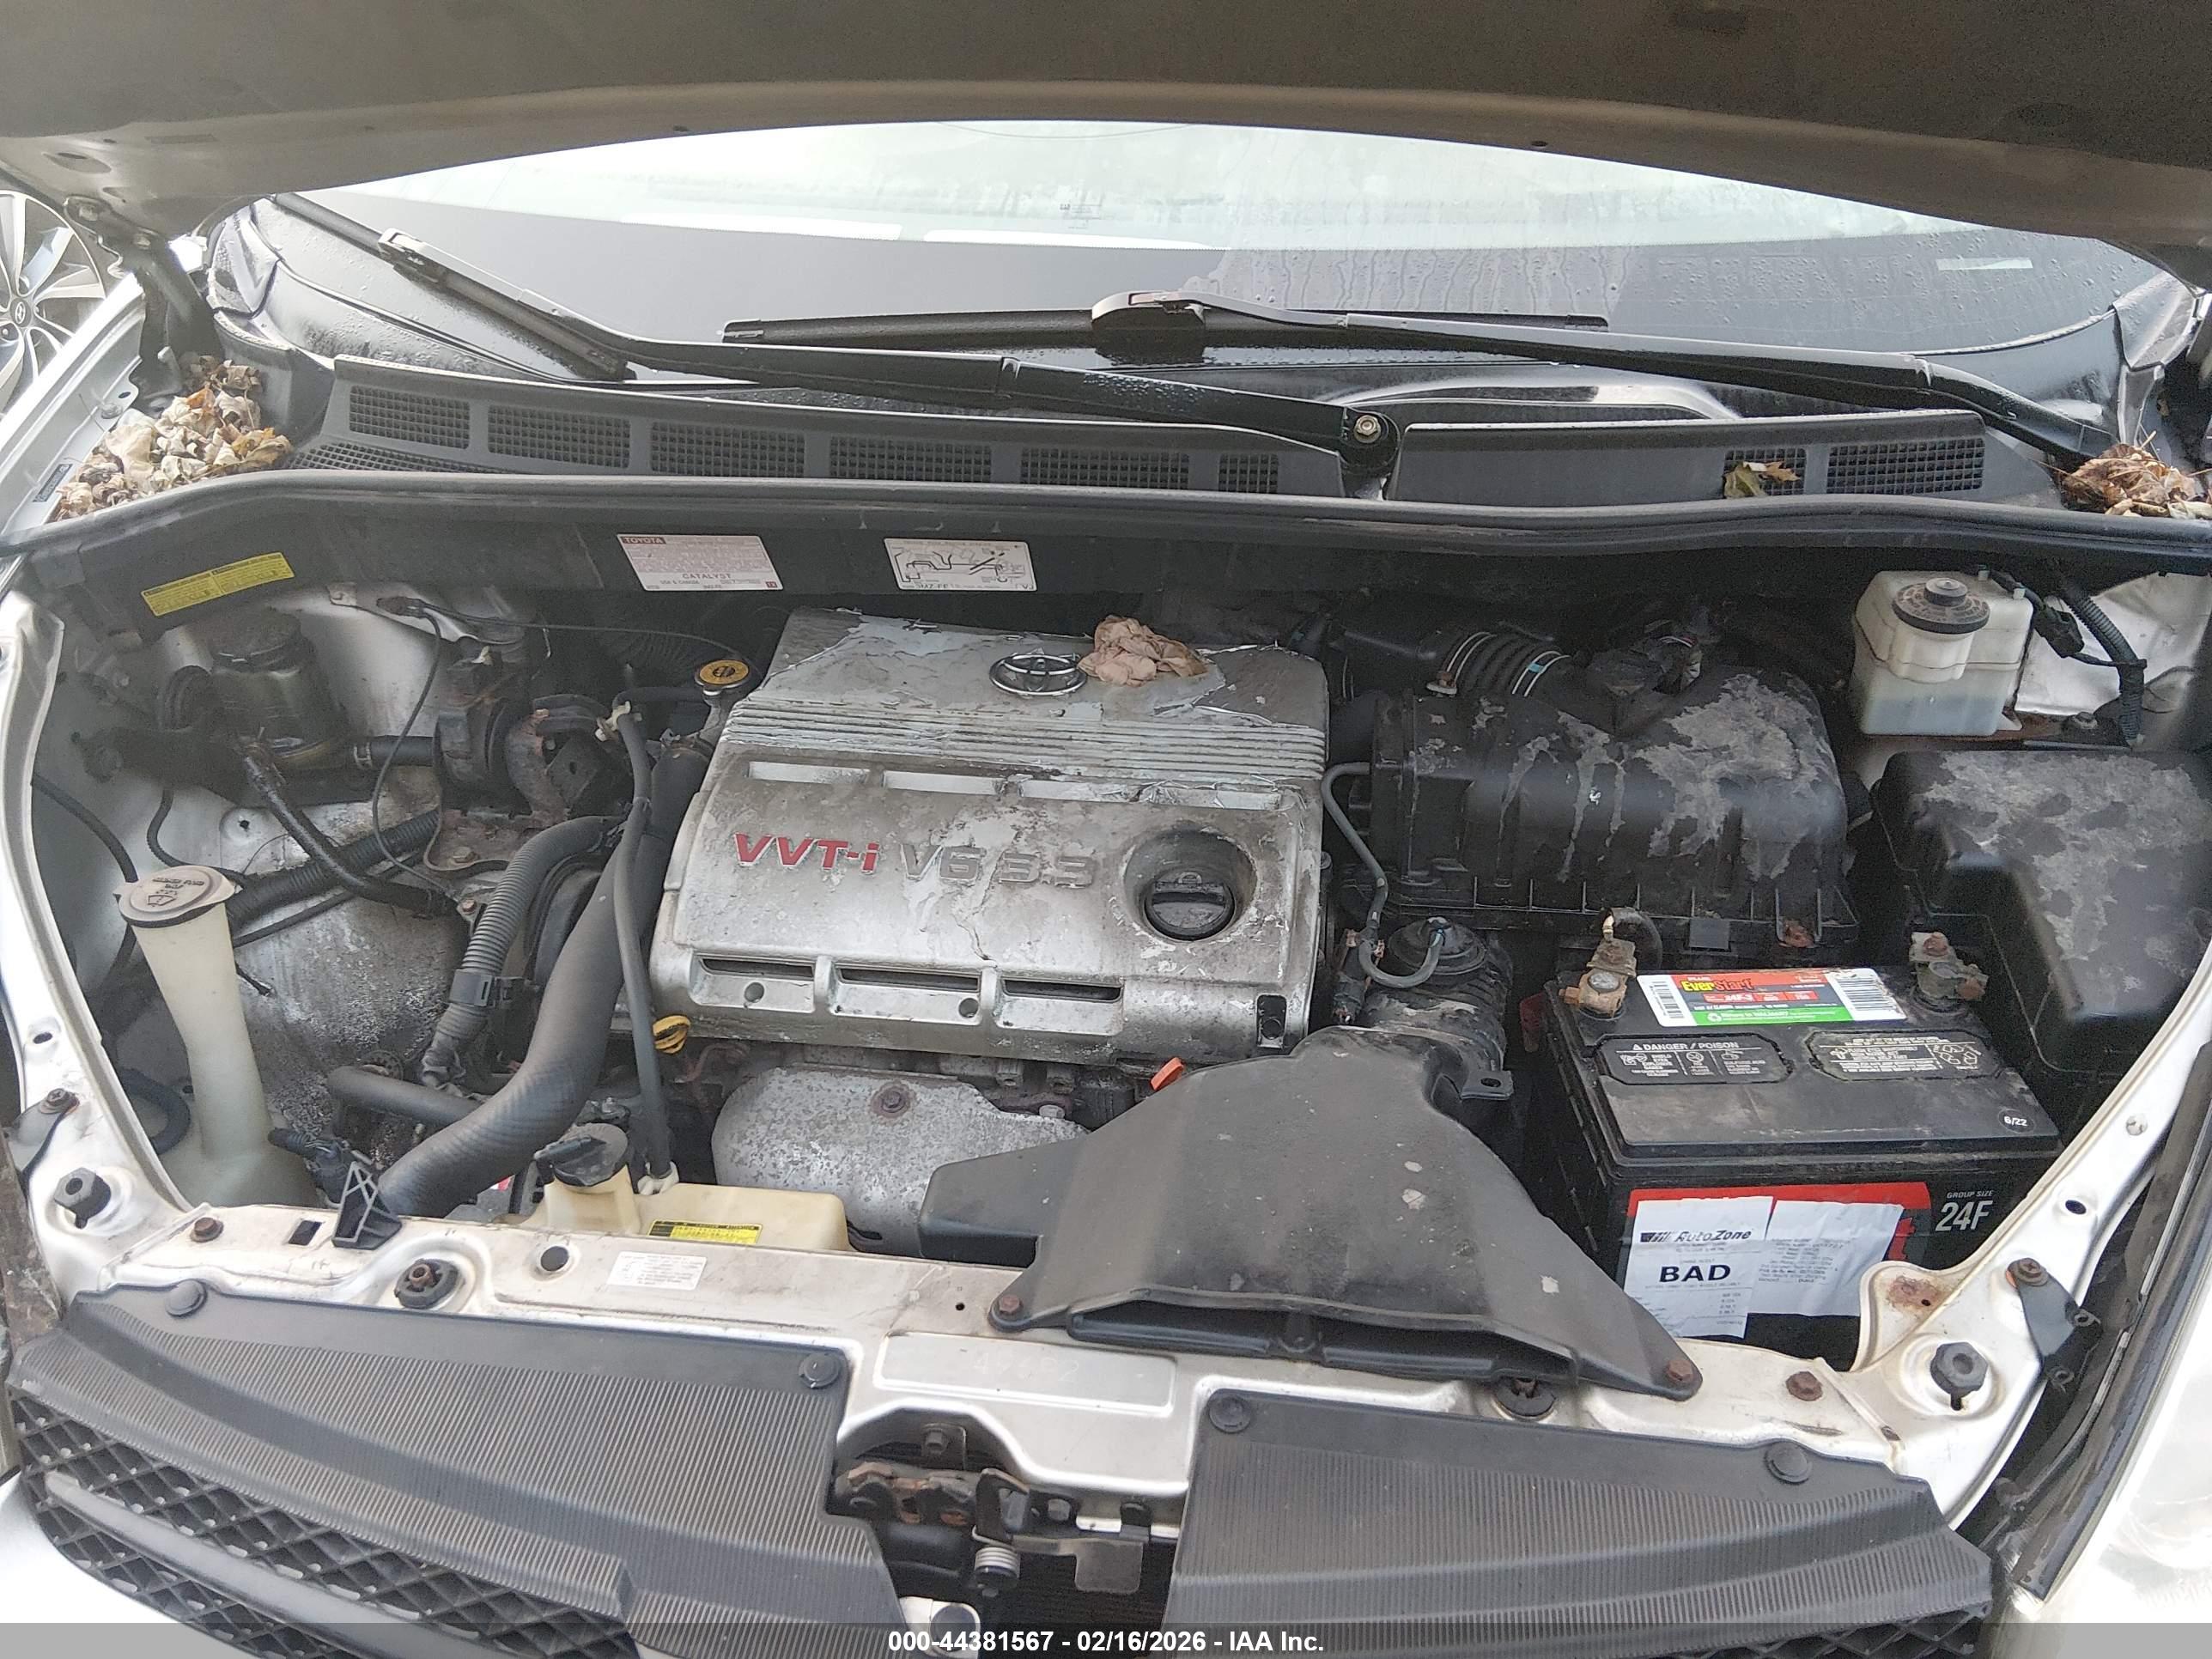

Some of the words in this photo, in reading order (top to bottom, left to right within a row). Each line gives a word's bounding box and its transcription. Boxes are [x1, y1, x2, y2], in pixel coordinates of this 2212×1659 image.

[732, 832, 880, 875] VVT-i
[900, 844, 987, 881] V6
[1680, 979, 1753, 992] EverStart
[2003, 1115, 2027, 1127] 6/22
[1946, 1190, 1976, 1199] GROUP
[1935, 1200, 1994, 1232] 24F
[1674, 1230, 1753, 1243] AutoZone
[1659, 1264, 1731, 1283] BAD
